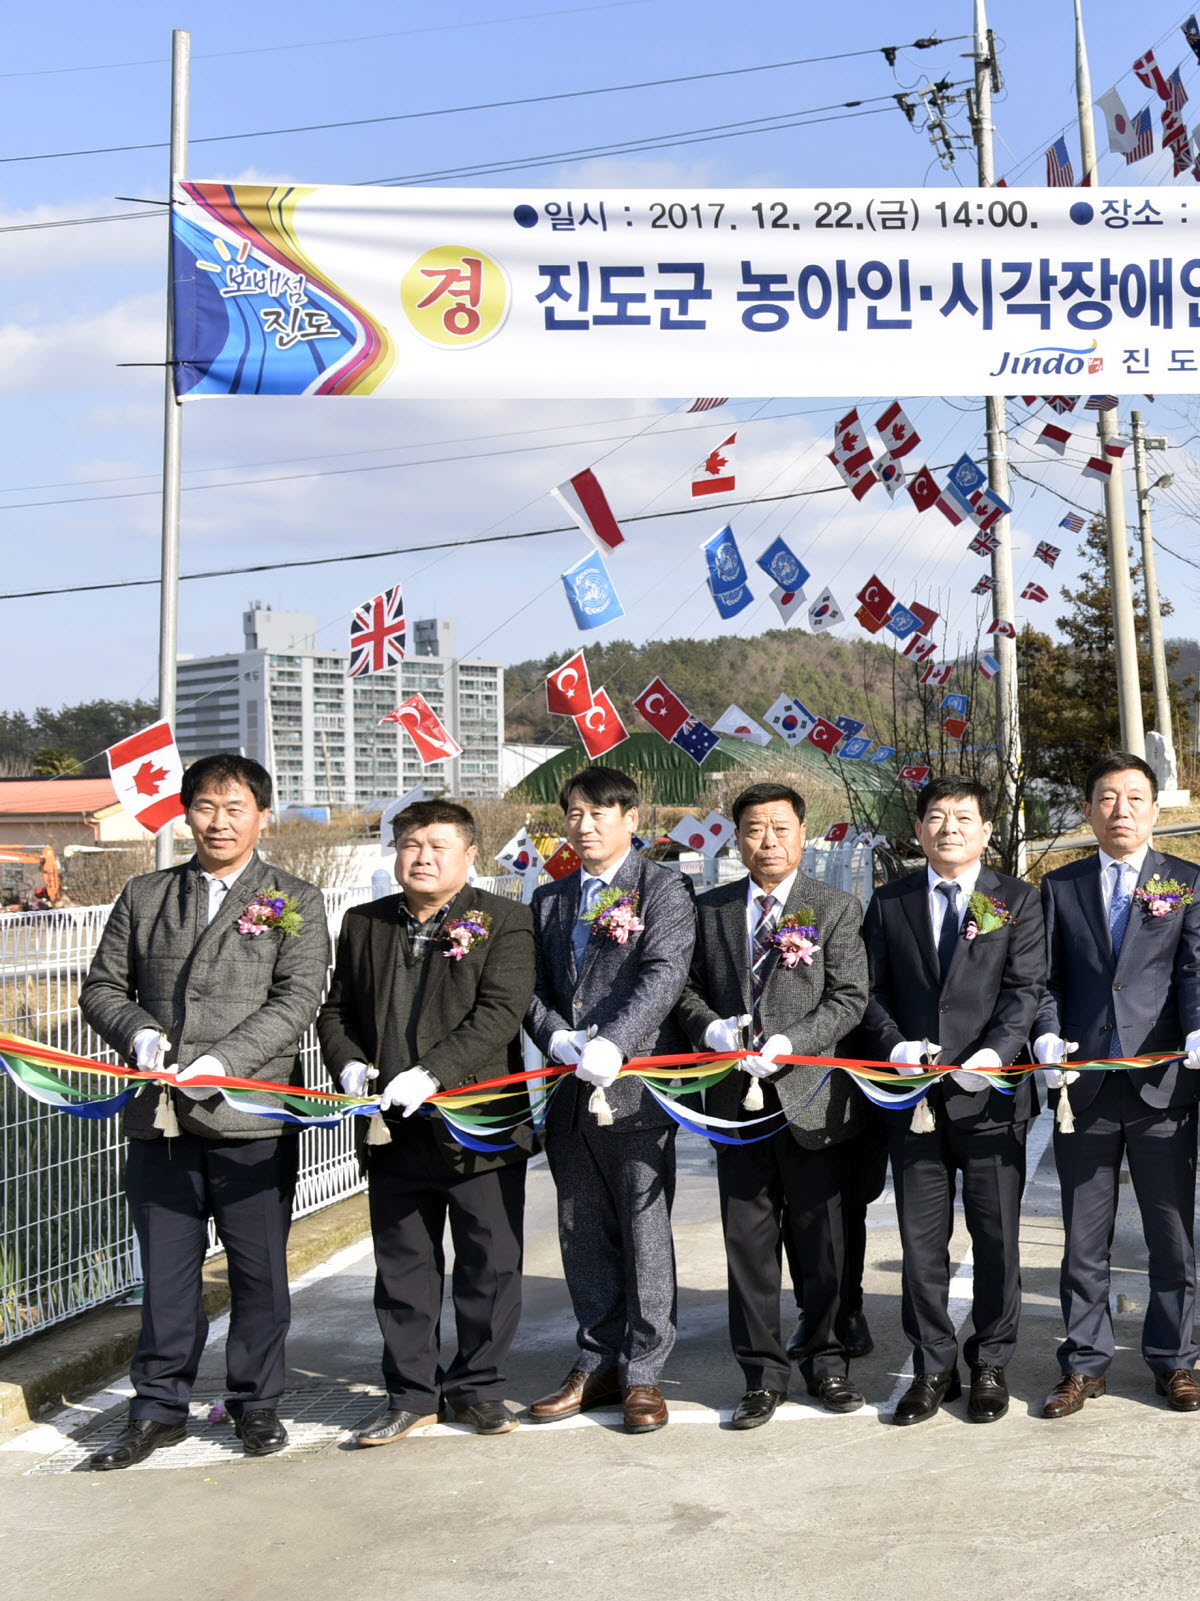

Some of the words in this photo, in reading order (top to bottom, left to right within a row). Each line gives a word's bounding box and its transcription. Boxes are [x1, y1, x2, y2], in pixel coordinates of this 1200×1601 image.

[543, 201, 608, 232] 일시
[649, 202, 737, 231] 2017.
[751, 202, 801, 231] 12.
[814, 198, 920, 232] 22.(금)
[935, 200, 1038, 229] 14:00.
[1099, 198, 1164, 229] 장소
[221, 266, 305, 304] 보배섬
[416, 257, 483, 336] 경
[535, 260, 713, 331] 진도군
[263, 307, 339, 347] 진도
[989, 351, 1085, 377] Jindo
